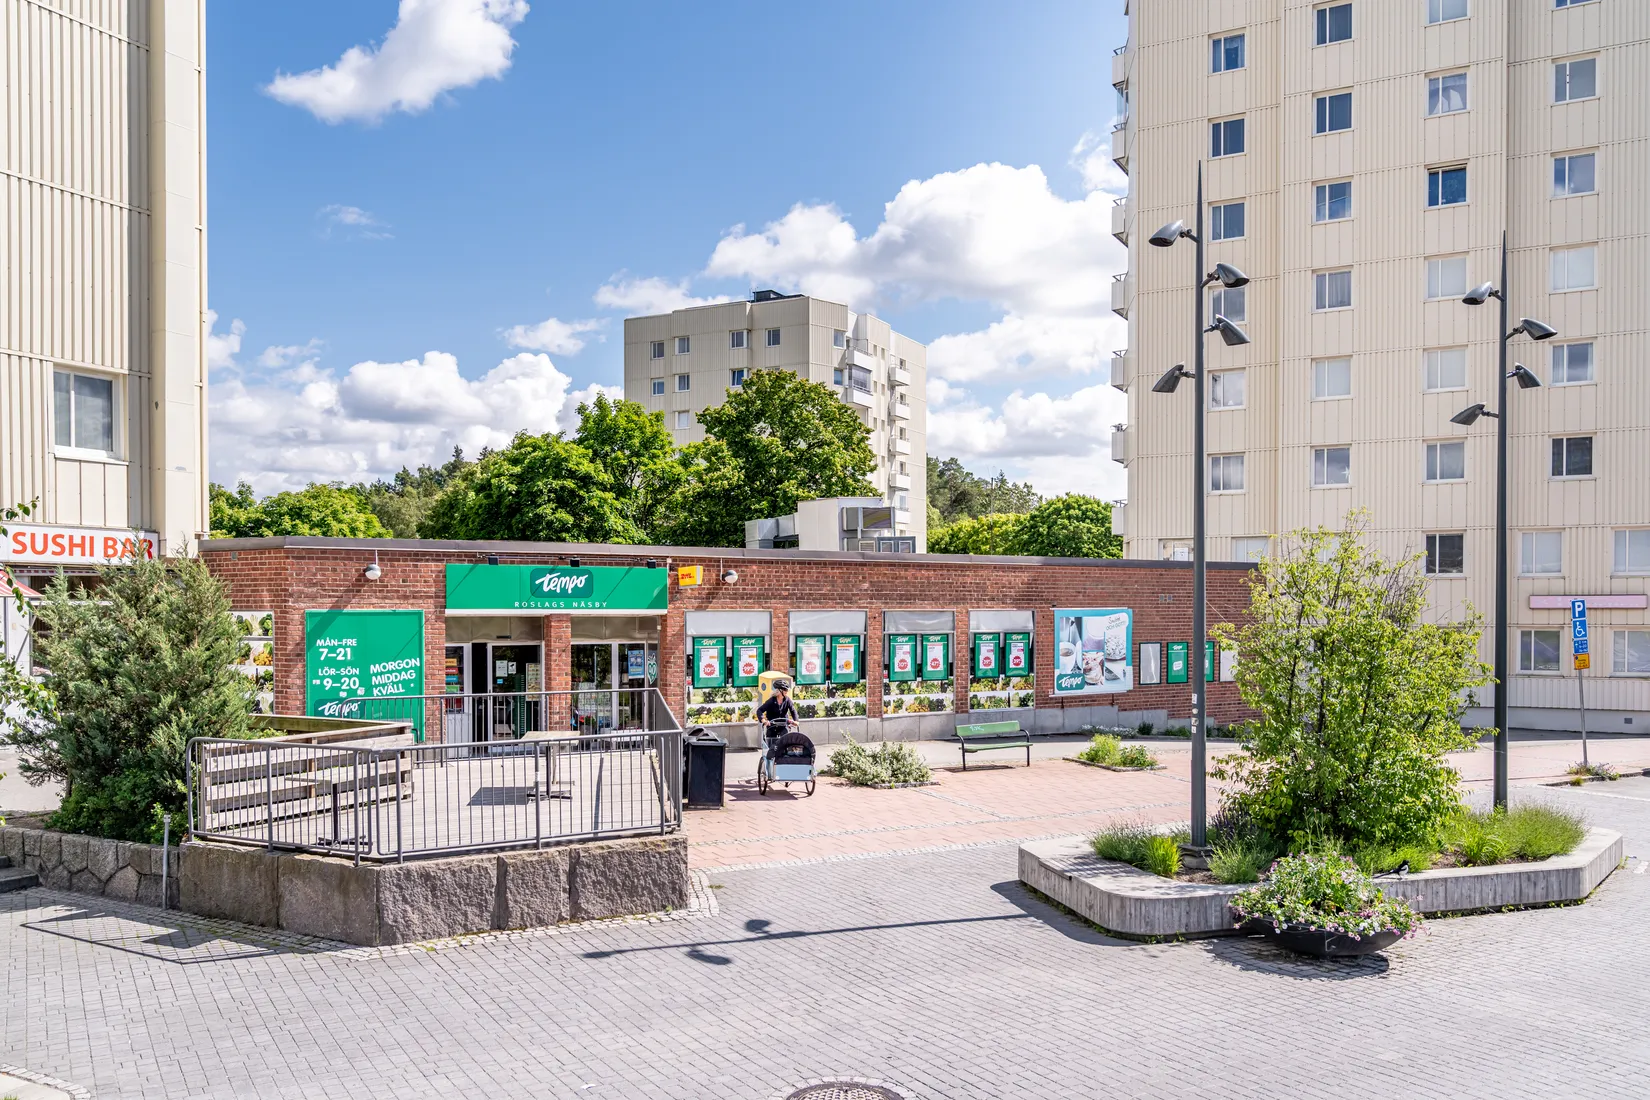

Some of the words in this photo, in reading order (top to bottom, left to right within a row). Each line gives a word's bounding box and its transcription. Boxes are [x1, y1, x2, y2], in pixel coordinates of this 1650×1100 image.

[12, 531, 94, 557] SUSHI
[572, 600, 608, 608] NÄSBY
[1574, 601, 1583, 618] P
[370, 657, 420, 674] MORGON
[371, 669, 416, 686] MIDDAG
[373, 682, 405, 697] KVÄLL
